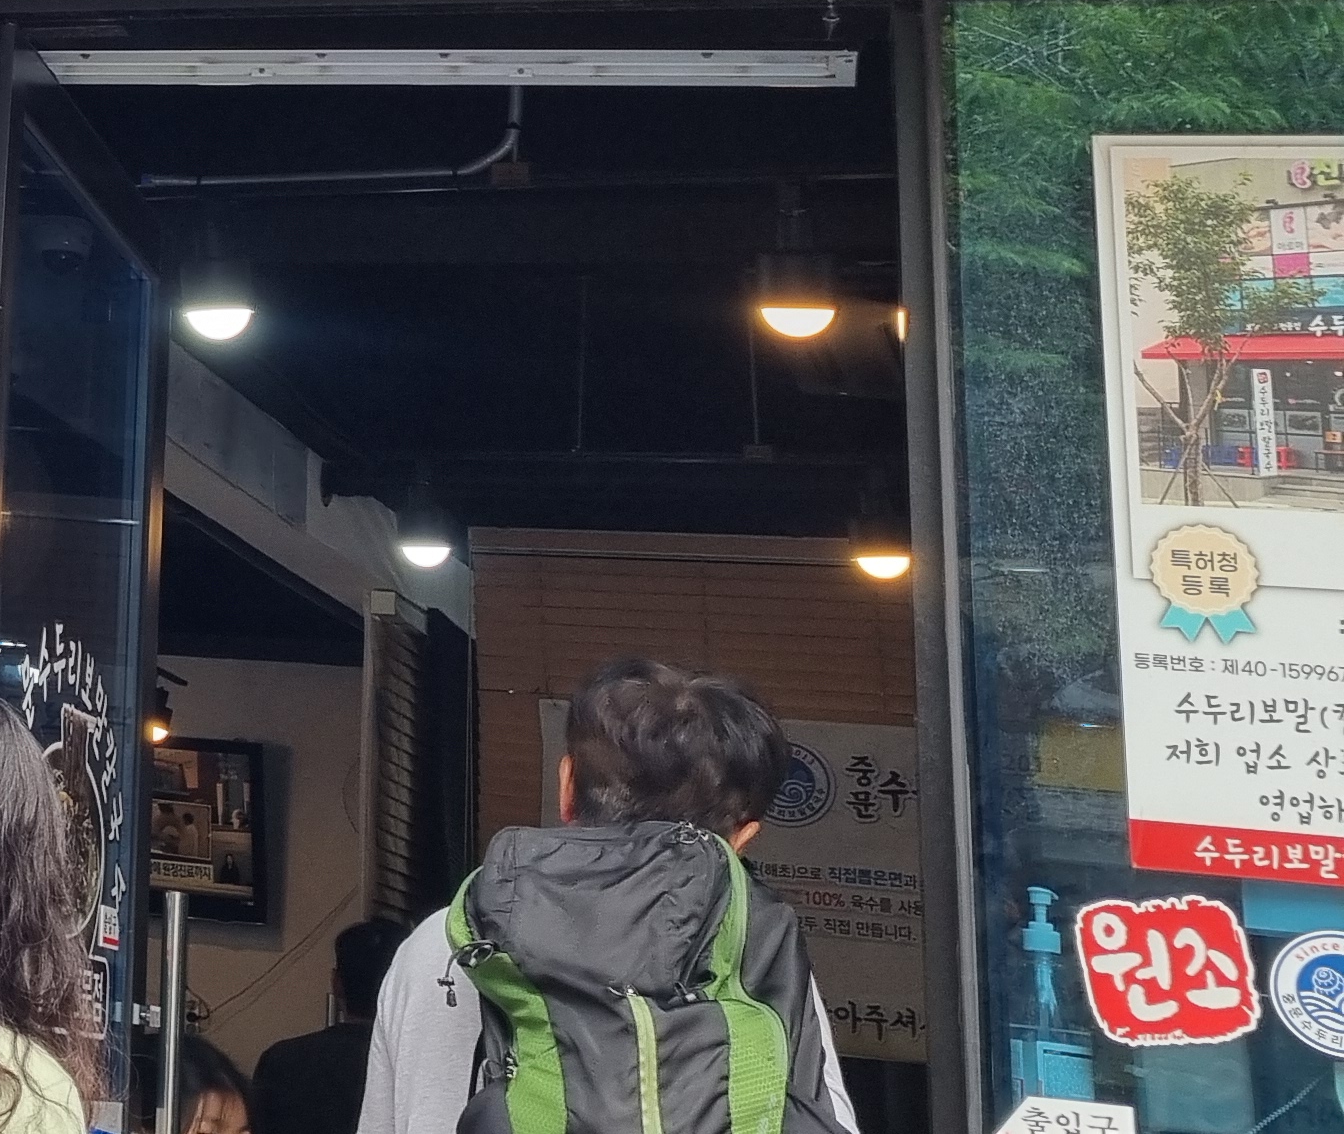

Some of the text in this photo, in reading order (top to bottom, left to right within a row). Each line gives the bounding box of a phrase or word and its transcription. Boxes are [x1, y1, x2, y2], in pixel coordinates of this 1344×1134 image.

[1170, 549, 1239, 574] 특허청
[1180, 575, 1232, 598] 등록
[1133, 653, 1206, 673] 등록번호
[1165, 738, 1221, 767] 저희
[1236, 741, 1292, 775] 업소
[878, 771, 917, 813] 수
[1090, 911, 1242, 1022] 원조
[1294, 941, 1341, 962] since
[1281, 992, 1344, 1048] 중문수두리
